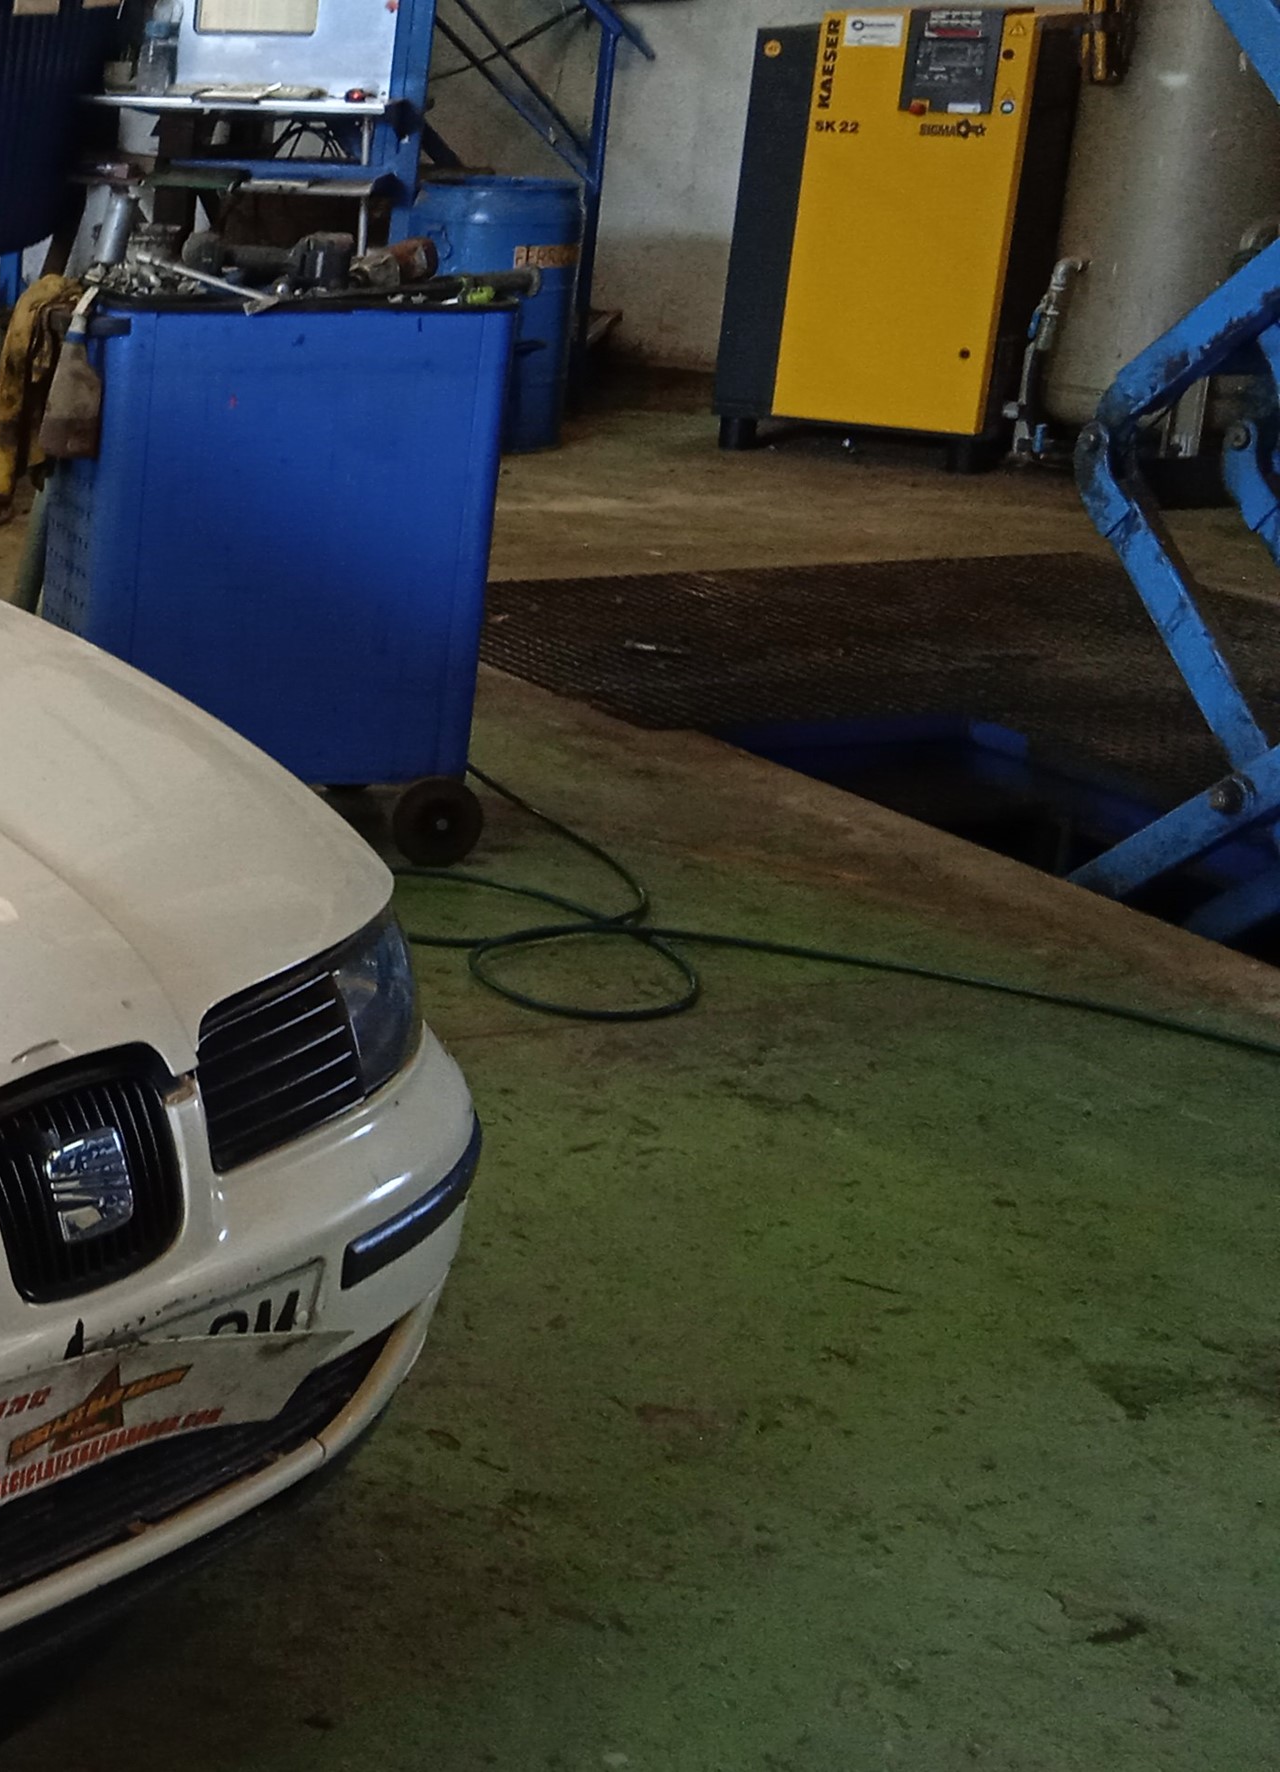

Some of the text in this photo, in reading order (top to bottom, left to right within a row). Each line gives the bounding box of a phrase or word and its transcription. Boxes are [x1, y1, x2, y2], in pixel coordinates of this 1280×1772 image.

[818, 18, 841, 109] KAESER
[815, 121, 860, 134] SK 22
